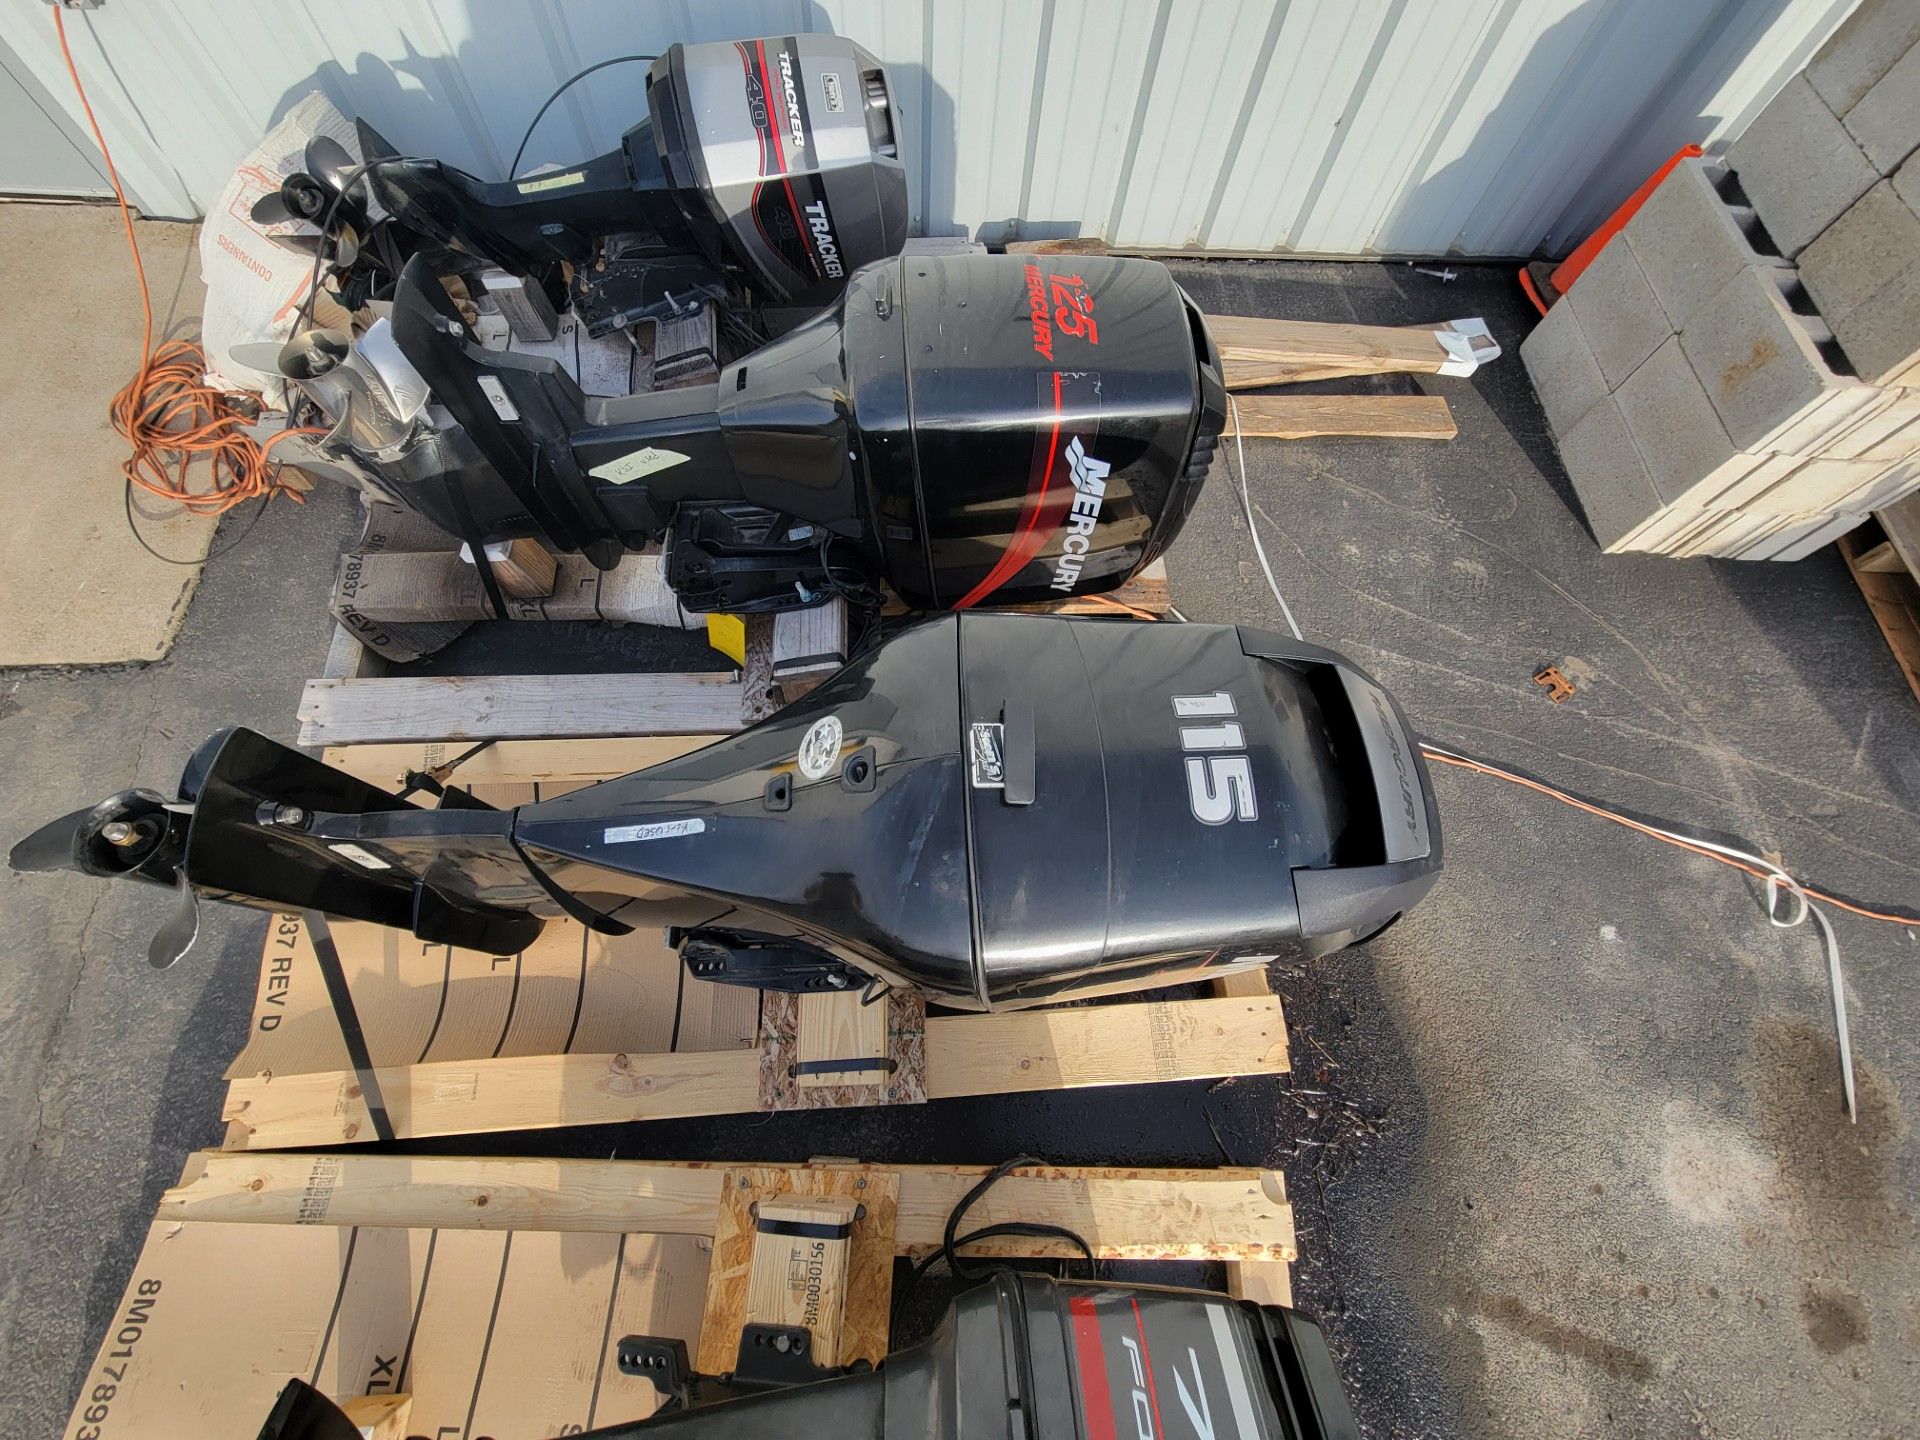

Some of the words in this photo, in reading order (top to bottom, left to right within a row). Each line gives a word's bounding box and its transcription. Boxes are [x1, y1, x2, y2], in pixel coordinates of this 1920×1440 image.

[747, 74, 768, 128] 40
[777, 51, 805, 148] TRACKER
[217, 234, 273, 282] CONTAINERS
[805, 200, 844, 279] TRACKER
[1024, 263, 1054, 362] MERCURY
[1049, 271, 1098, 345] 125
[1050, 452, 1111, 592] MERCURY
[339, 604, 378, 632] REV
[371, 634, 391, 646] D
[1170, 689, 1259, 826] 115
[1369, 690, 1419, 844] MERCURY
[270, 957, 292, 1007] REV
[260, 1015, 282, 1032] D
[804, 1242, 825, 1326] 8M0030156
[366, 1354, 398, 1396] XL
